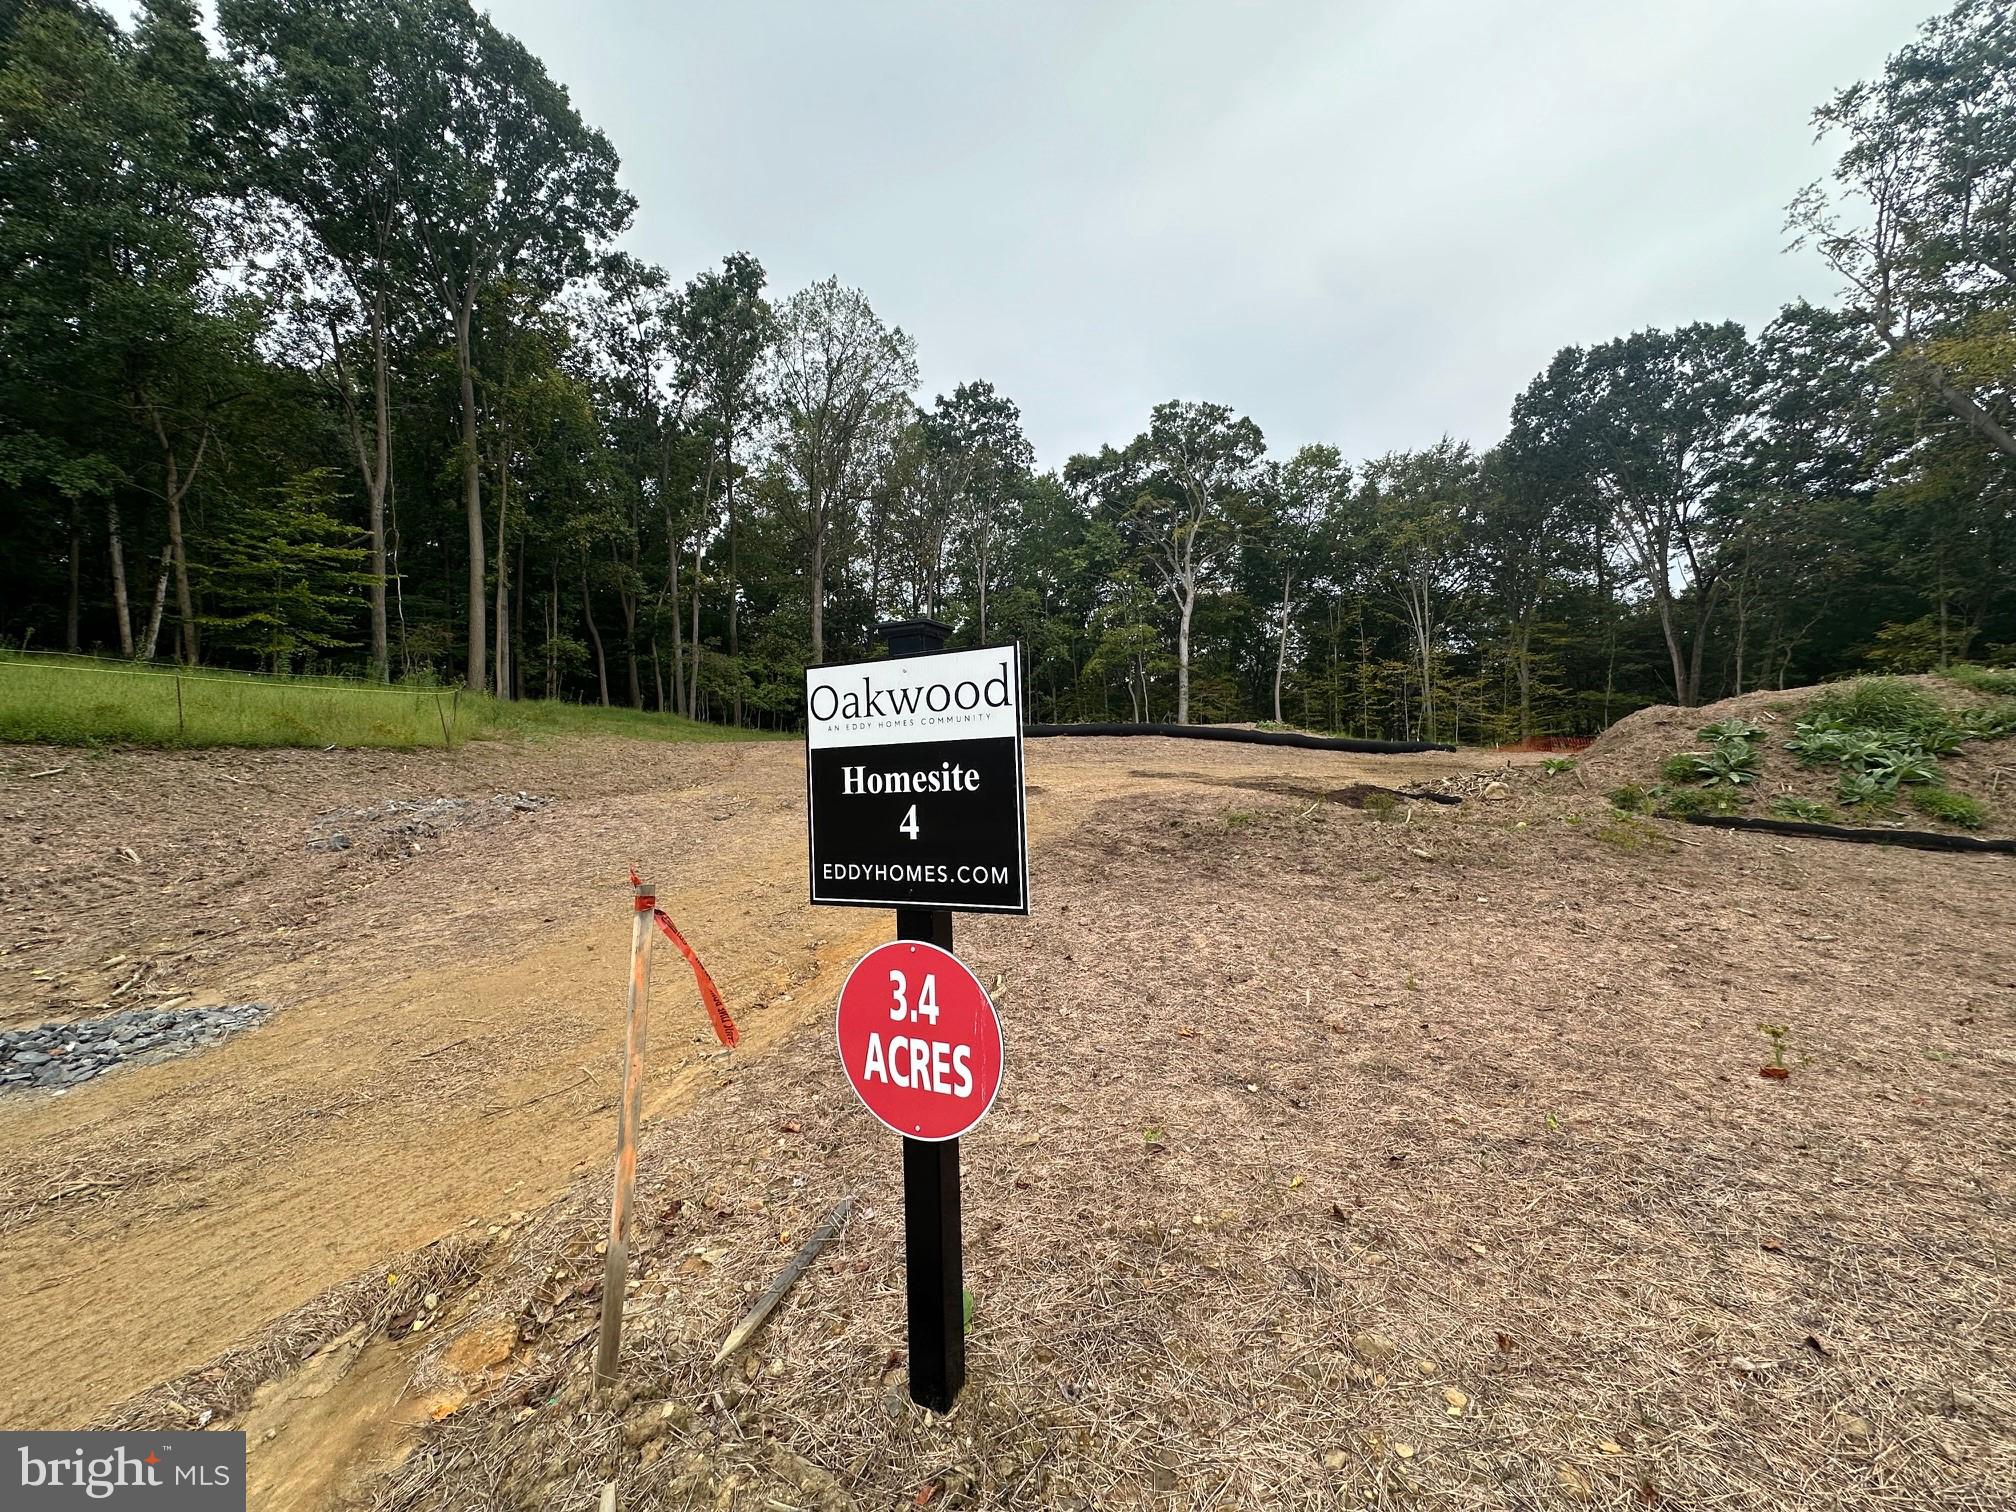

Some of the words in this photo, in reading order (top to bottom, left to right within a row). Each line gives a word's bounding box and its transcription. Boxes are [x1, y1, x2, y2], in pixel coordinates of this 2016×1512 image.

[810, 662, 1013, 721] Oakwood
[846, 722, 872, 731] EDDY
[879, 719, 914, 728] HOMES
[921, 713, 991, 726] COMMUNITY
[841, 761, 980, 795] Homesite
[899, 804, 920, 840] 4
[823, 863, 1009, 884] EDDYHOMES.COM
[889, 969, 940, 1025] 3.4
[863, 1032, 973, 1098] ACRES
